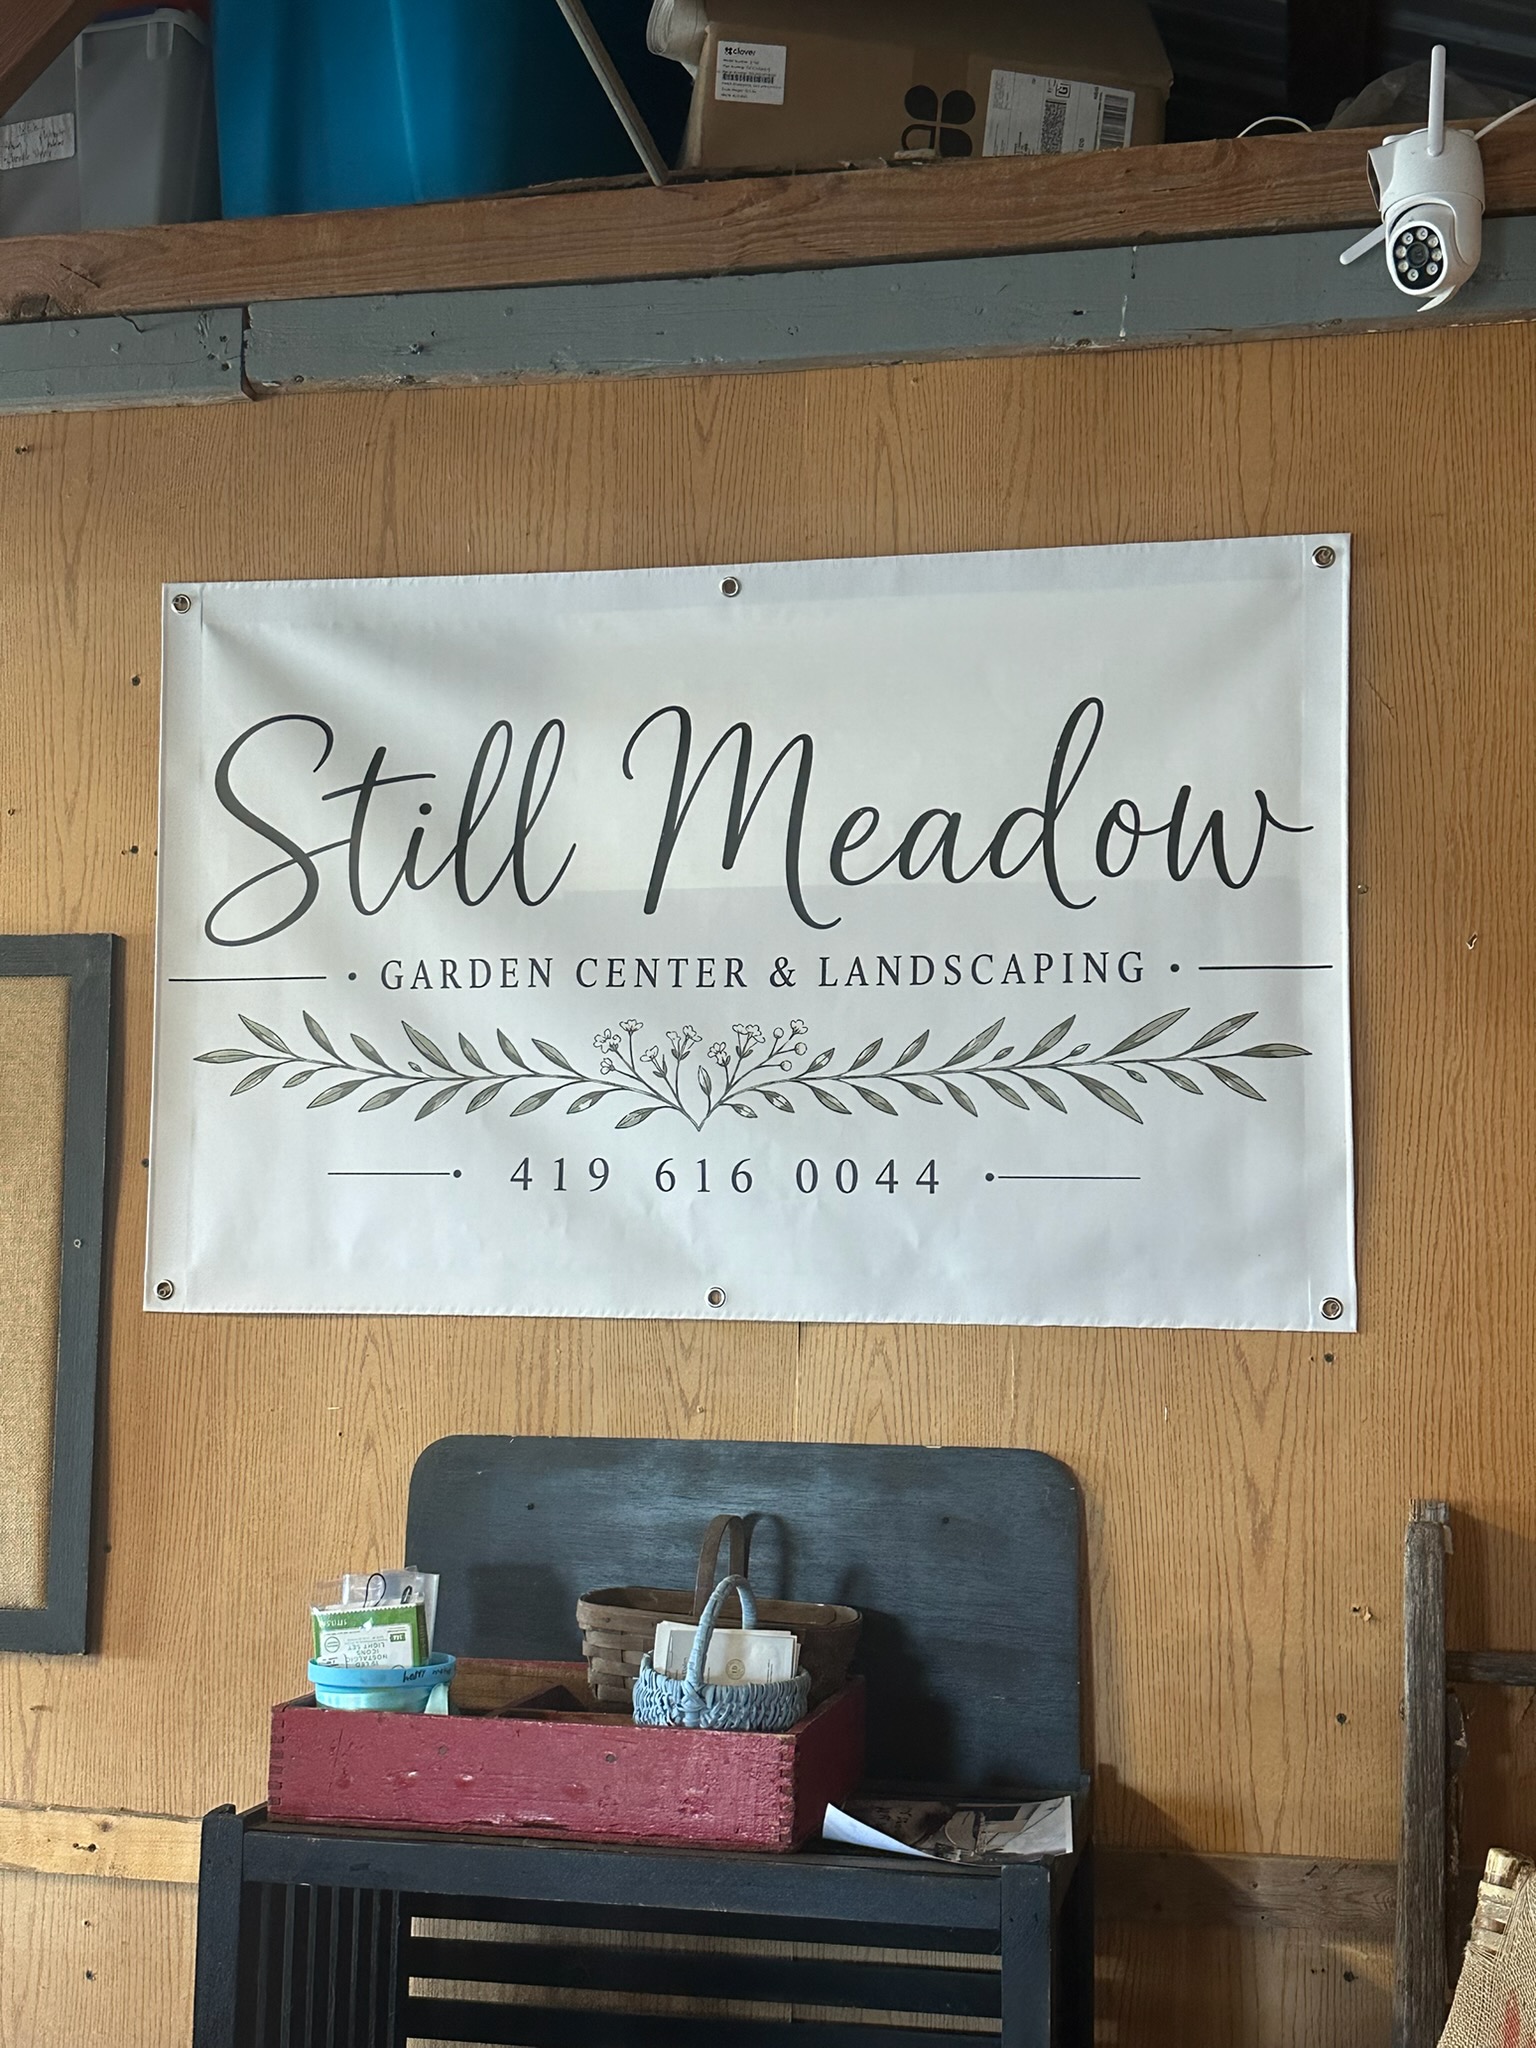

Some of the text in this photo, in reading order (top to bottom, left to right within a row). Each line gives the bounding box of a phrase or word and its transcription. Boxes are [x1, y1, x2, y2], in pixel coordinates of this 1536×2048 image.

[733, 47, 757, 56] clover
[204, 696, 1314, 947] Still Meadow
[381, 951, 1144, 990] GARDEN CENTER & LANDSCAPING
[510, 1157, 939, 1195] 419 616 0044
[363, 1642, 385, 1650] LIGHT
